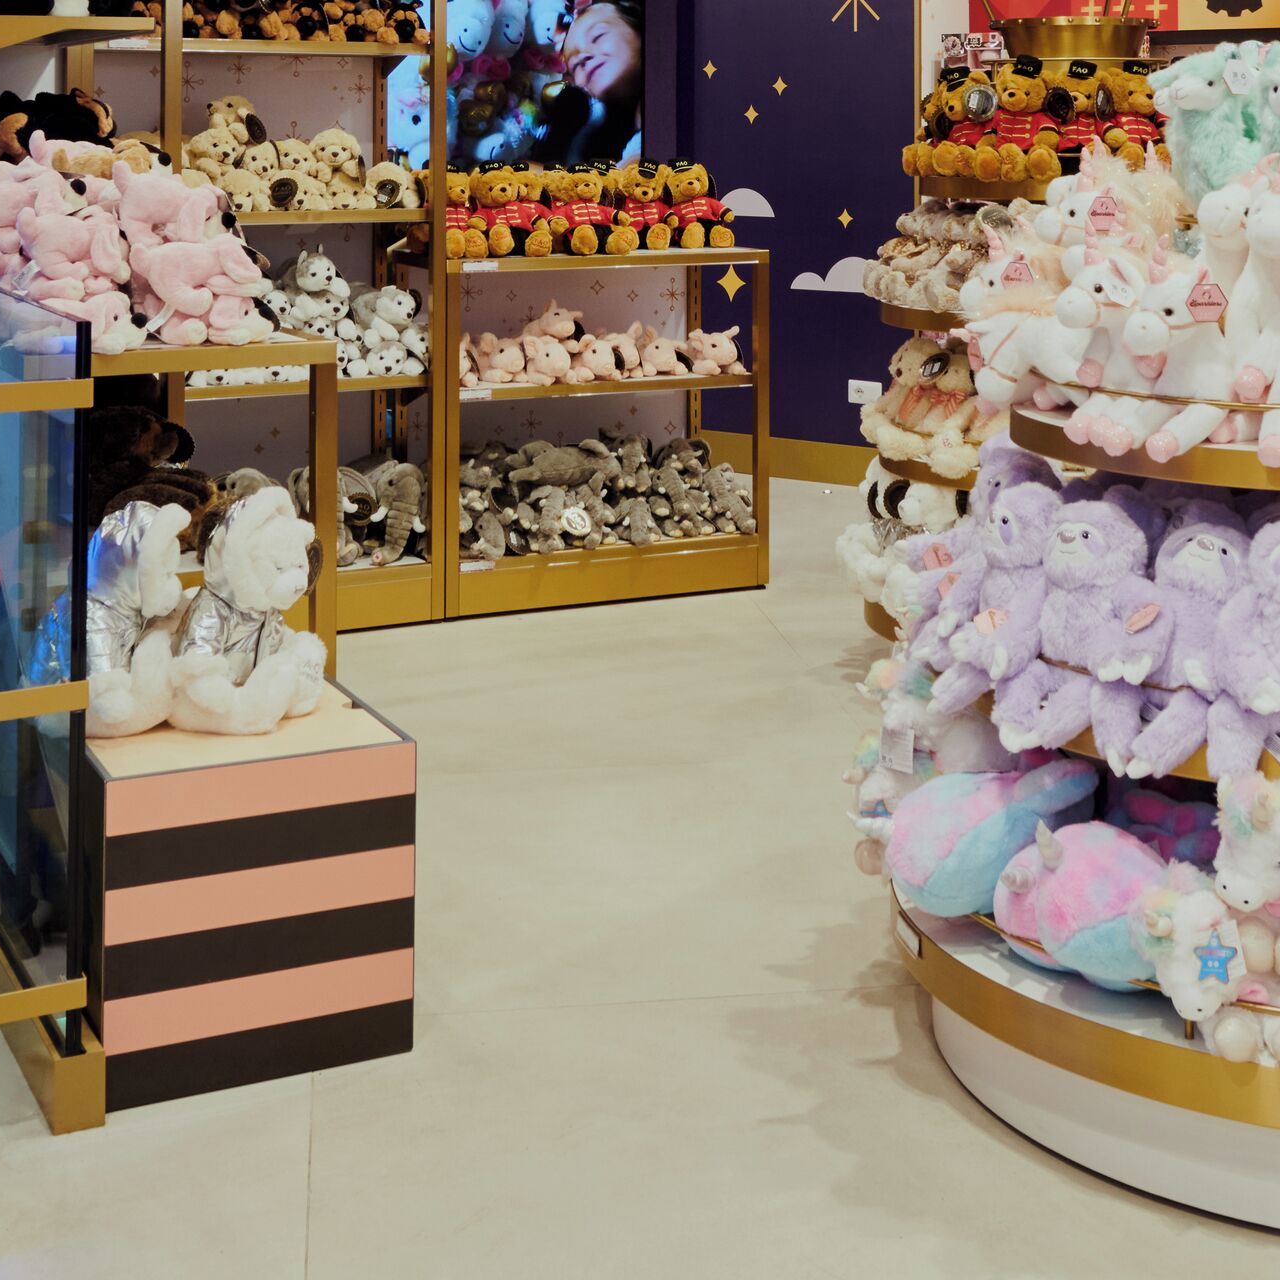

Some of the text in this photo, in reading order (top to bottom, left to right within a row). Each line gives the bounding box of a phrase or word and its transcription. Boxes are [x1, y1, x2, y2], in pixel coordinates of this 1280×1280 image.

[1072, 66, 1089, 74] FAO
[1132, 66, 1148, 74] FAO
[593, 162, 607, 170] FAO
[644, 162, 657, 170] FAO
